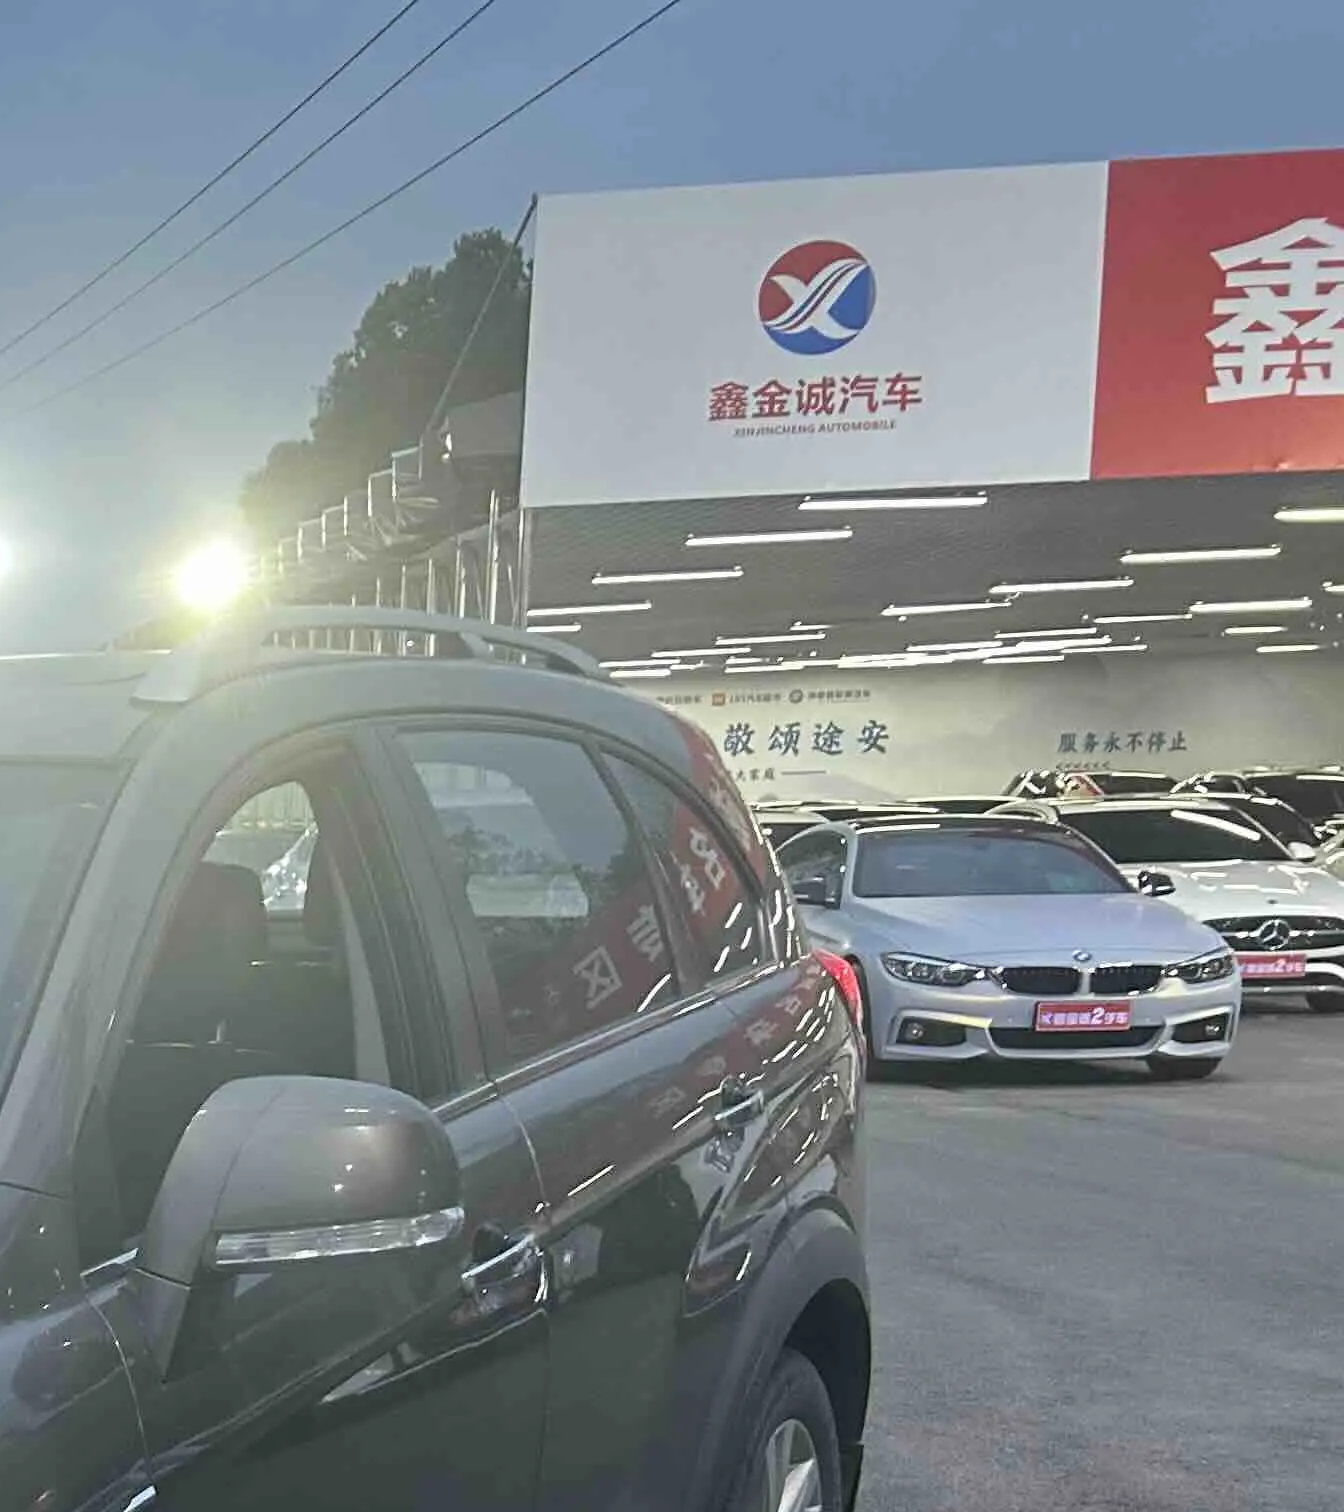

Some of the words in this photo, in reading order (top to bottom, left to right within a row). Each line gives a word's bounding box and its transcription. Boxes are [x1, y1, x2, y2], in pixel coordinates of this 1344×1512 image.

[1205, 217, 1344, 403] 鑫
[709, 372, 923, 421] 鑫金诚汽车
[819, 420, 896, 433] AUTOMOBILE
[724, 720, 889, 756] 敬颂途安
[1057, 731, 1187, 753] 服务永不停止
